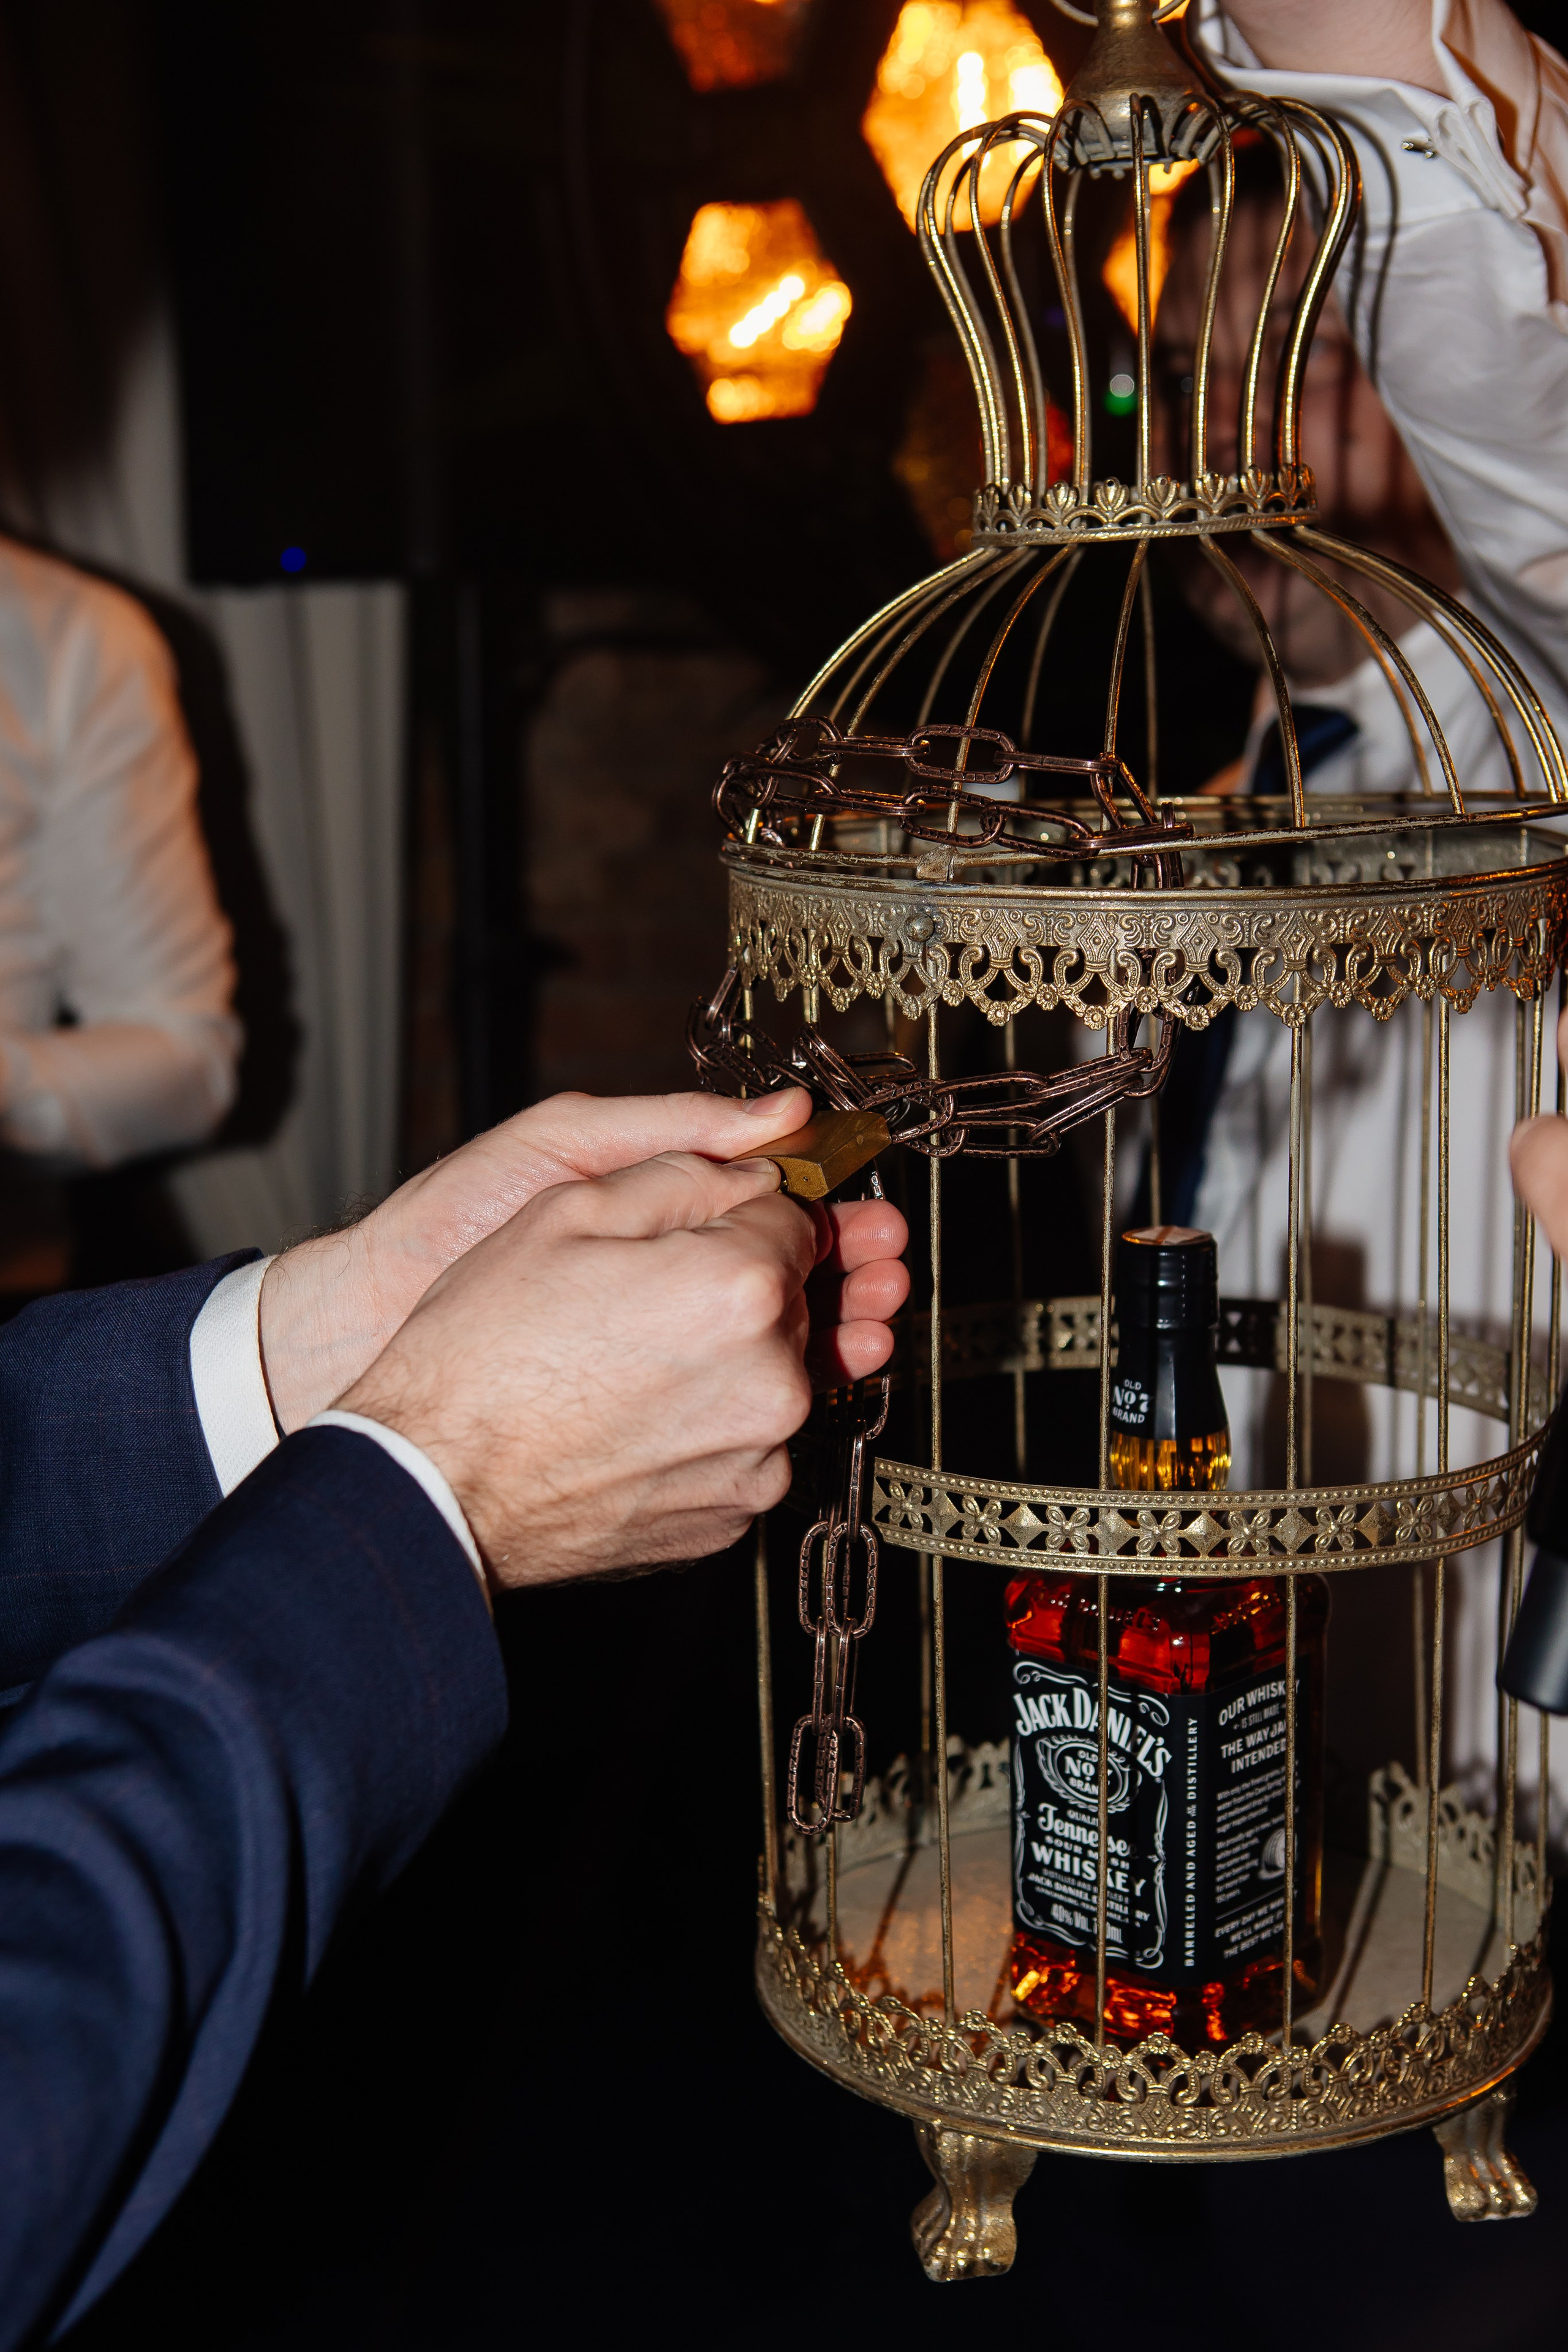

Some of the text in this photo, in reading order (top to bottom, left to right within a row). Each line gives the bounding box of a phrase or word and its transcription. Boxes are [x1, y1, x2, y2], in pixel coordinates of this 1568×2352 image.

[1124, 1379, 1142, 1390] OLD
[1112, 1407, 1145, 1423] BRAND
[1139, 1393, 1149, 1413] 7
[1013, 1693, 1073, 1736] JACK
[1218, 1679, 1300, 1726] OUR WHISKY
[1077, 1750, 1099, 1763] OLD
[1220, 1738, 1244, 1758] THE
[1245, 1726, 1270, 1749] WAY
[1186, 1718, 1198, 1800] DISTILLERY
[1069, 1777, 1099, 1796] BRAN
[1044, 1835, 1129, 1870] SOUR MSH
[1186, 1820, 1197, 1856] AGED
[1185, 1861, 1196, 1890] AND
[1184, 1894, 1196, 1967] BARRELED
